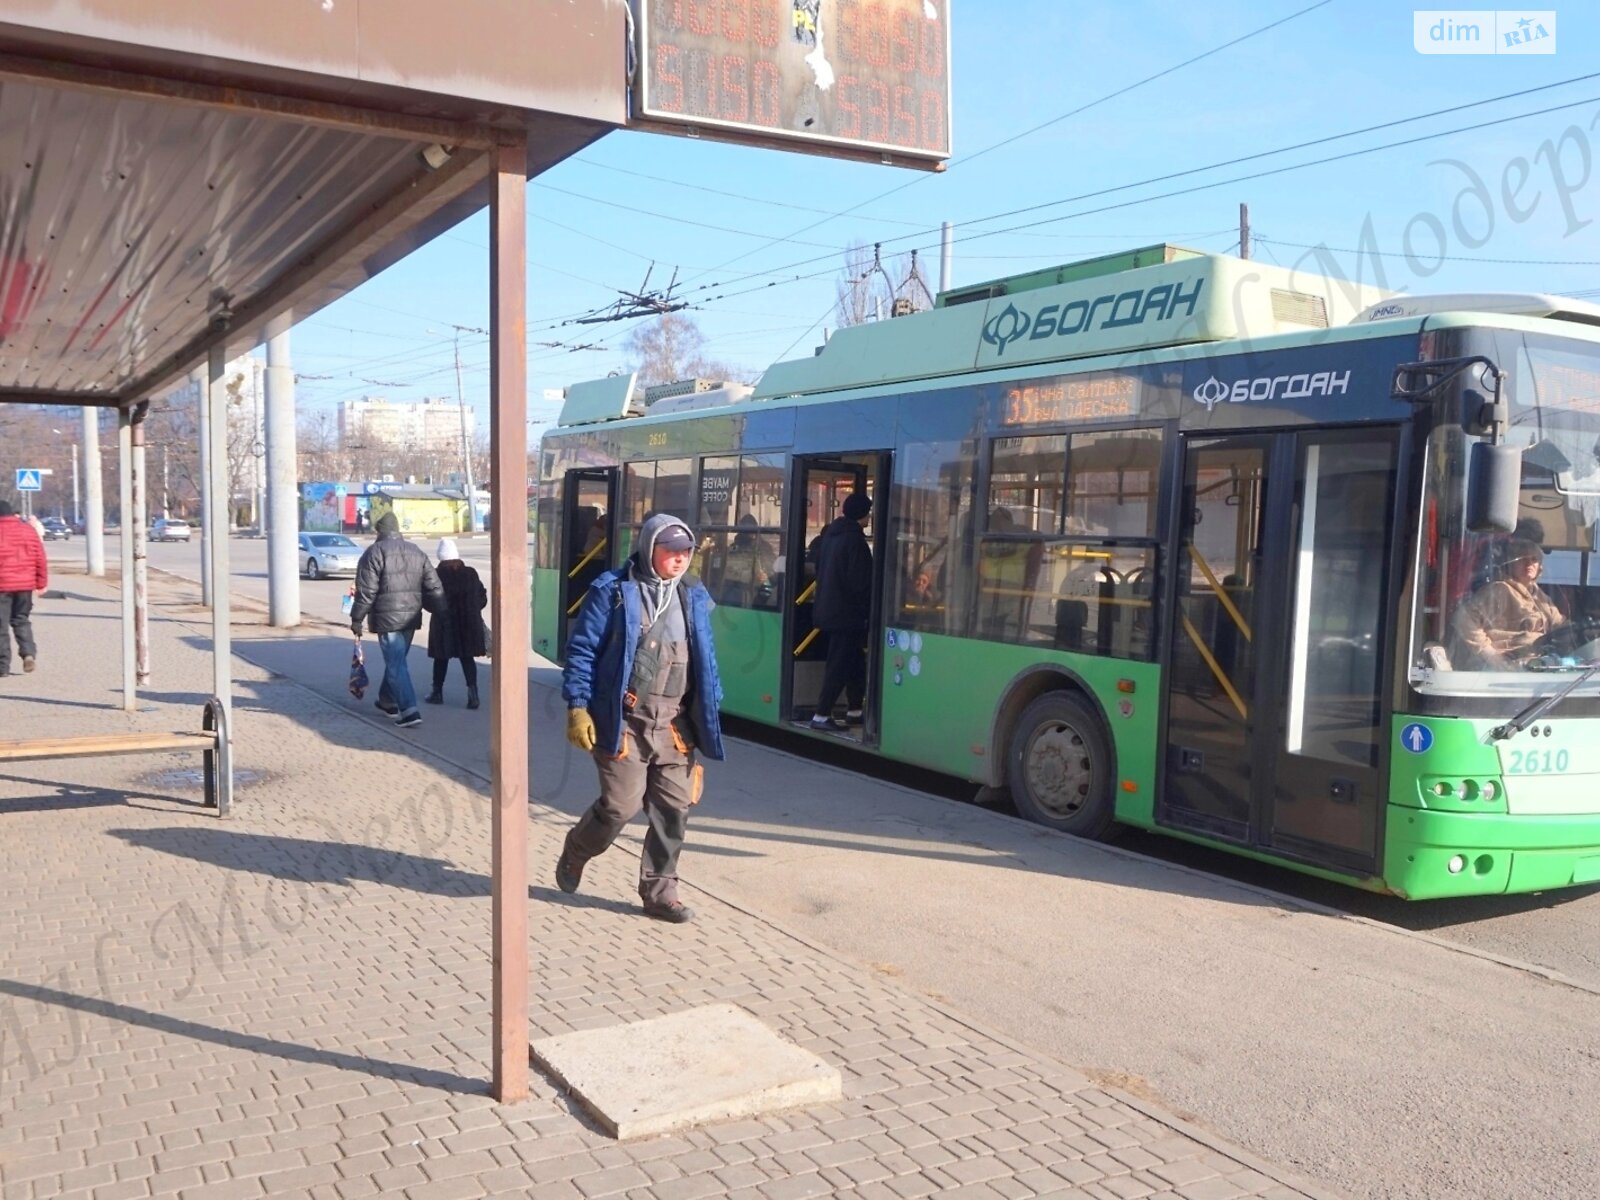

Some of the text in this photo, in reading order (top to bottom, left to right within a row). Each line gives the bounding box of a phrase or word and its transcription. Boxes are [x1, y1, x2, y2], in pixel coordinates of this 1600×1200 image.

[1030, 278, 1204, 341] БОГДАН
[1230, 370, 1351, 402] БОГДАН
[1007, 387, 1035, 424] 35
[1509, 749, 1568, 773] 2610
